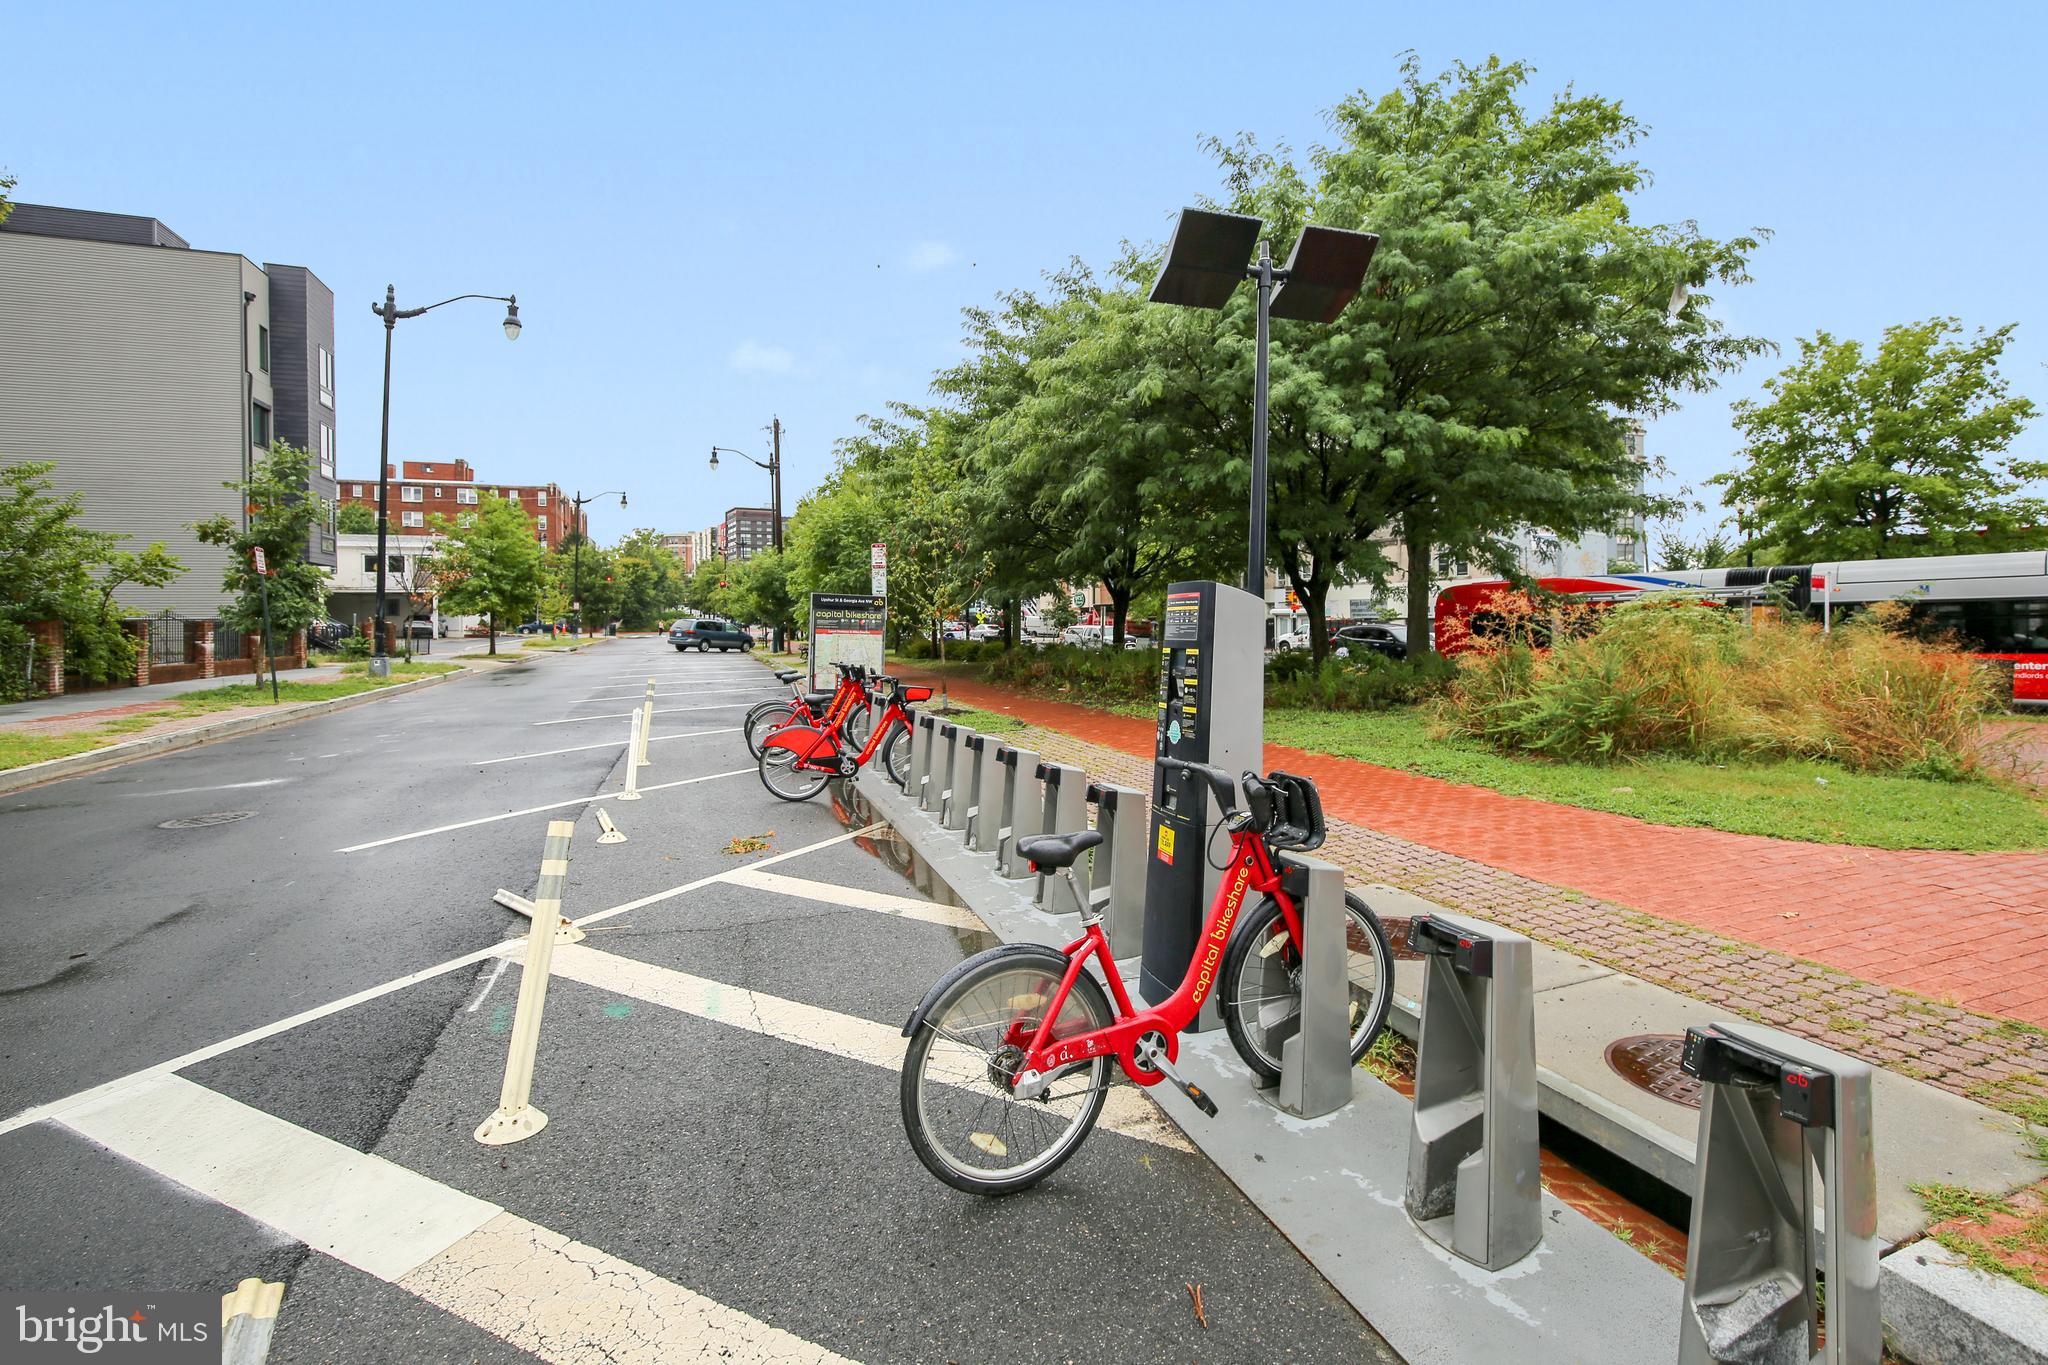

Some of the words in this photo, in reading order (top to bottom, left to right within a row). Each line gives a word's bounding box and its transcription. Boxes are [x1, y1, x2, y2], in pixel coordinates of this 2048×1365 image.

[816, 610, 844, 619] capital
[845, 610, 882, 619] bikeshare
[1192, 943, 1220, 1003] capital
[1210, 867, 1249, 941] bikeshare
